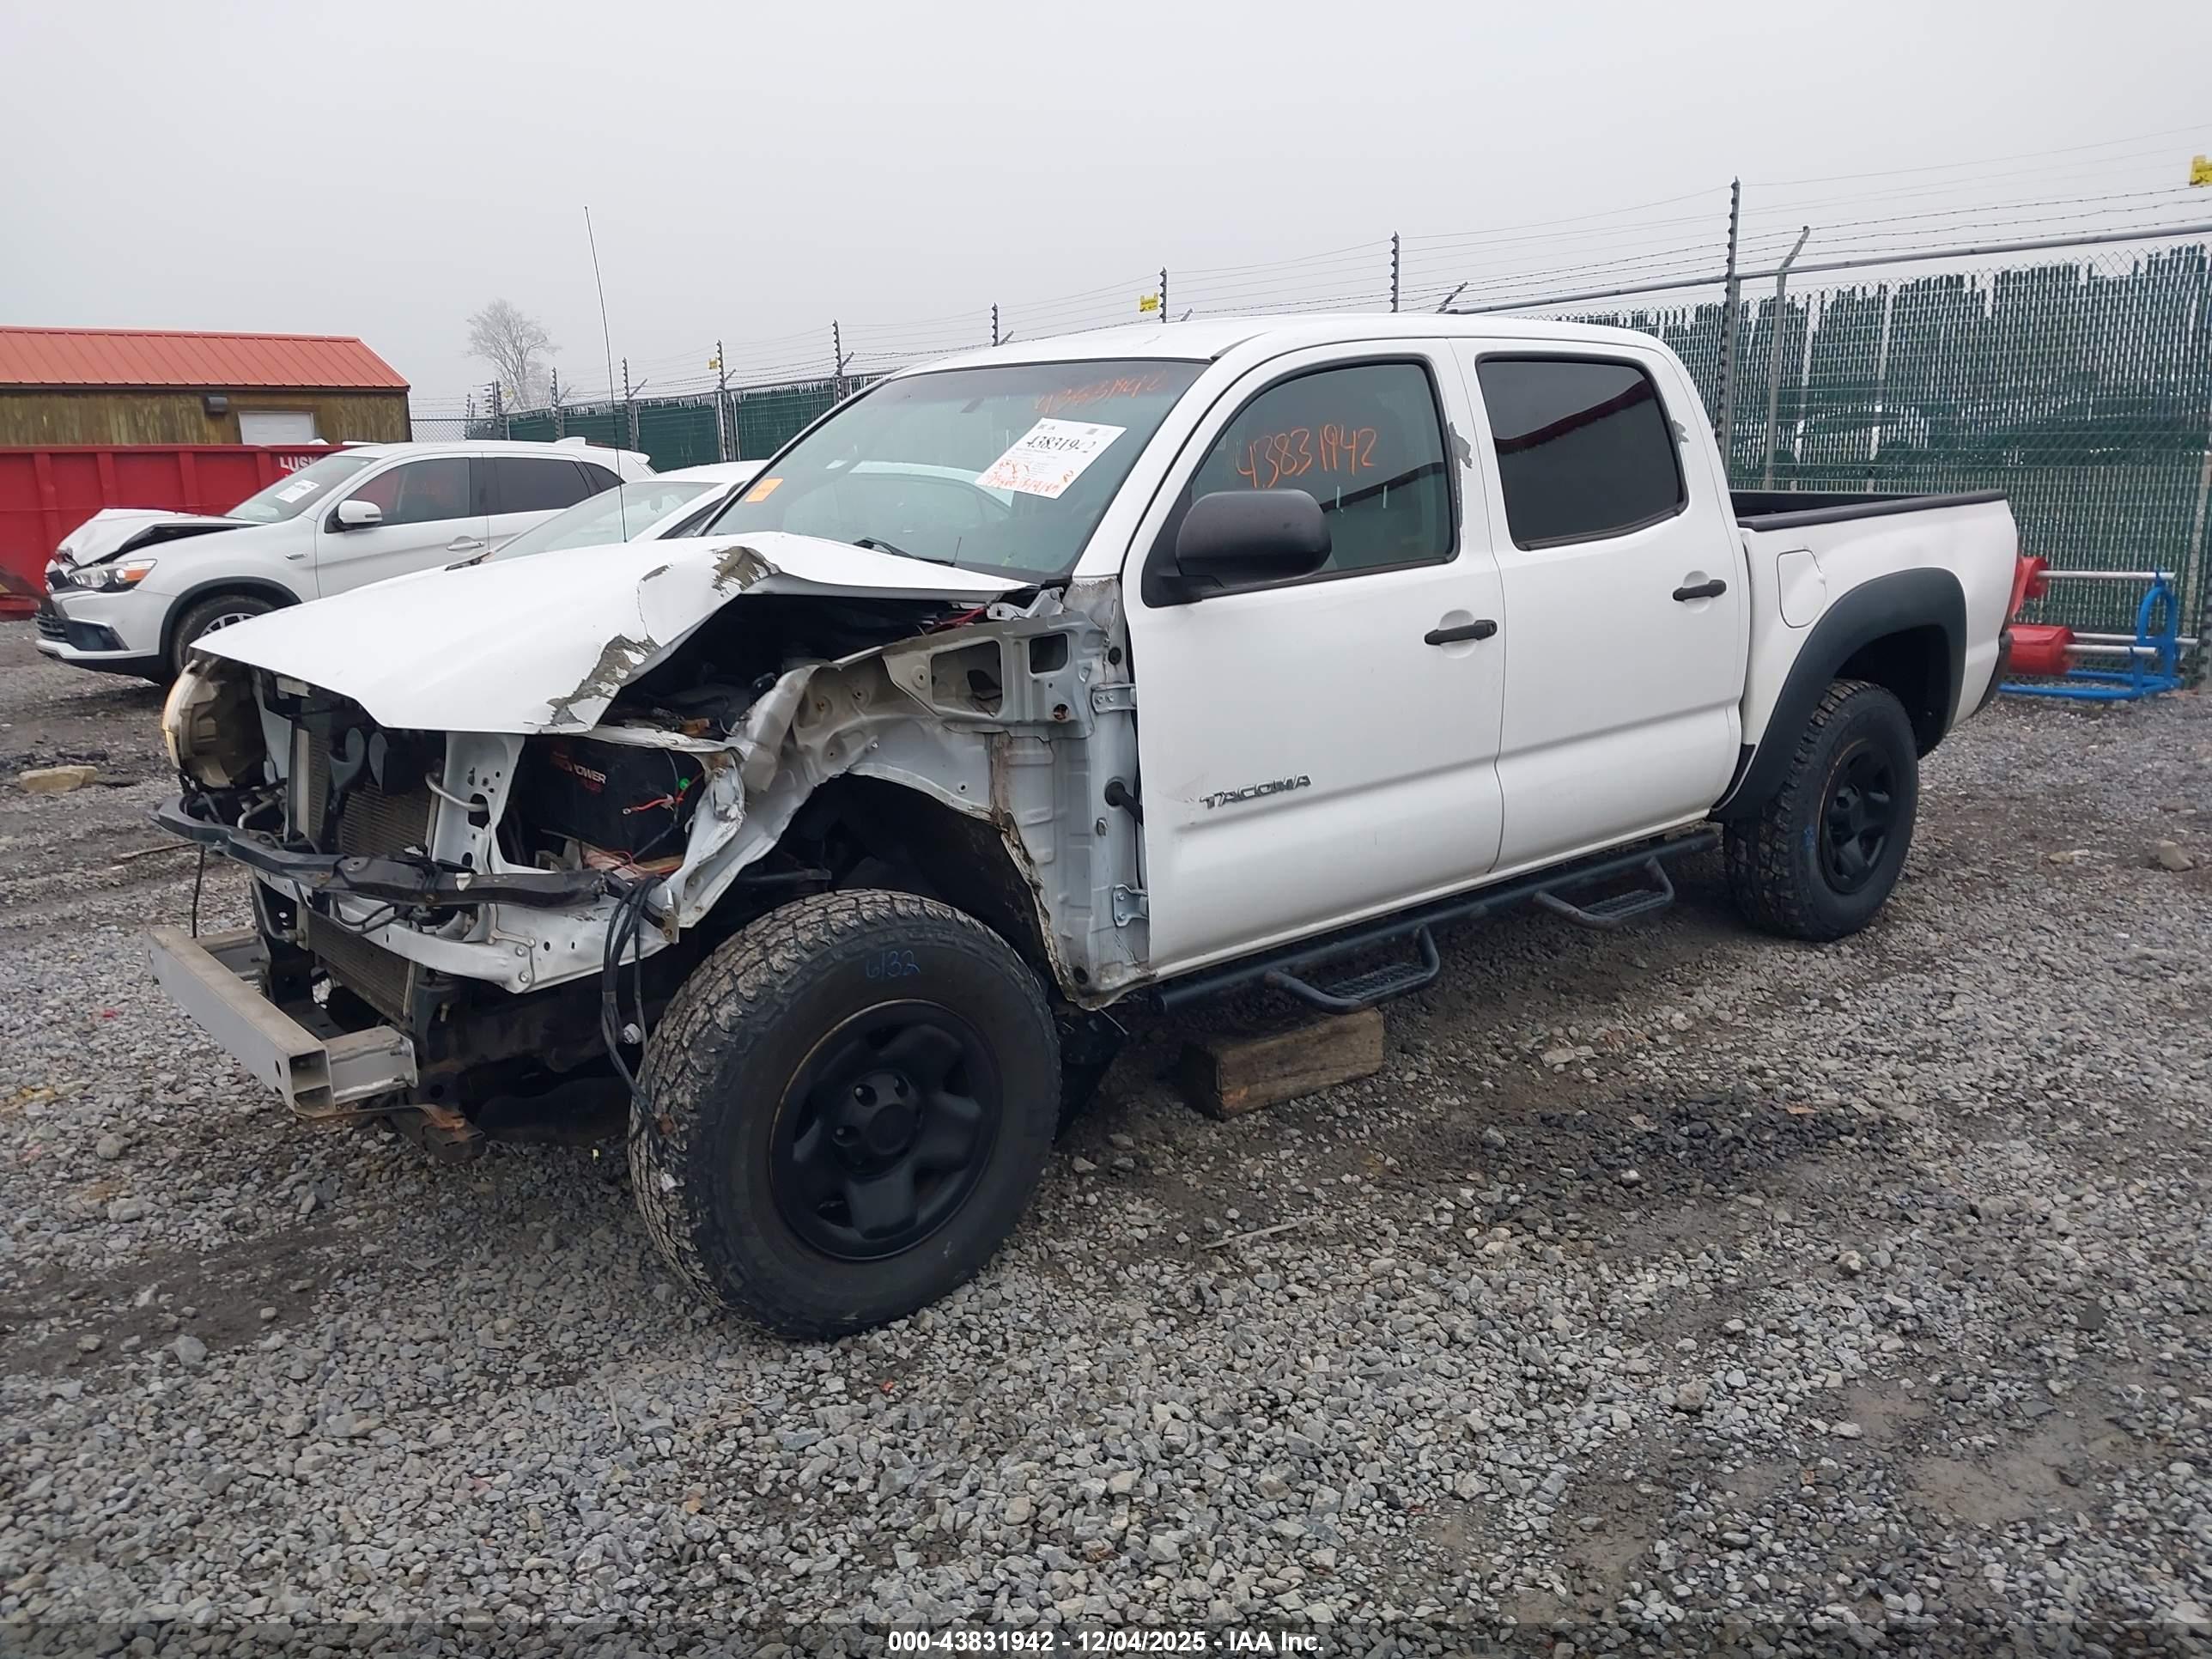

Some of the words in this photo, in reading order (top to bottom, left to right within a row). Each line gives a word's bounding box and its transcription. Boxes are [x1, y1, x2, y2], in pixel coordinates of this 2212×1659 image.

[1026, 434, 1097, 453] 4383192
[1235, 423, 1378, 489] 43831942
[1199, 774, 1313, 810] TACOMA
